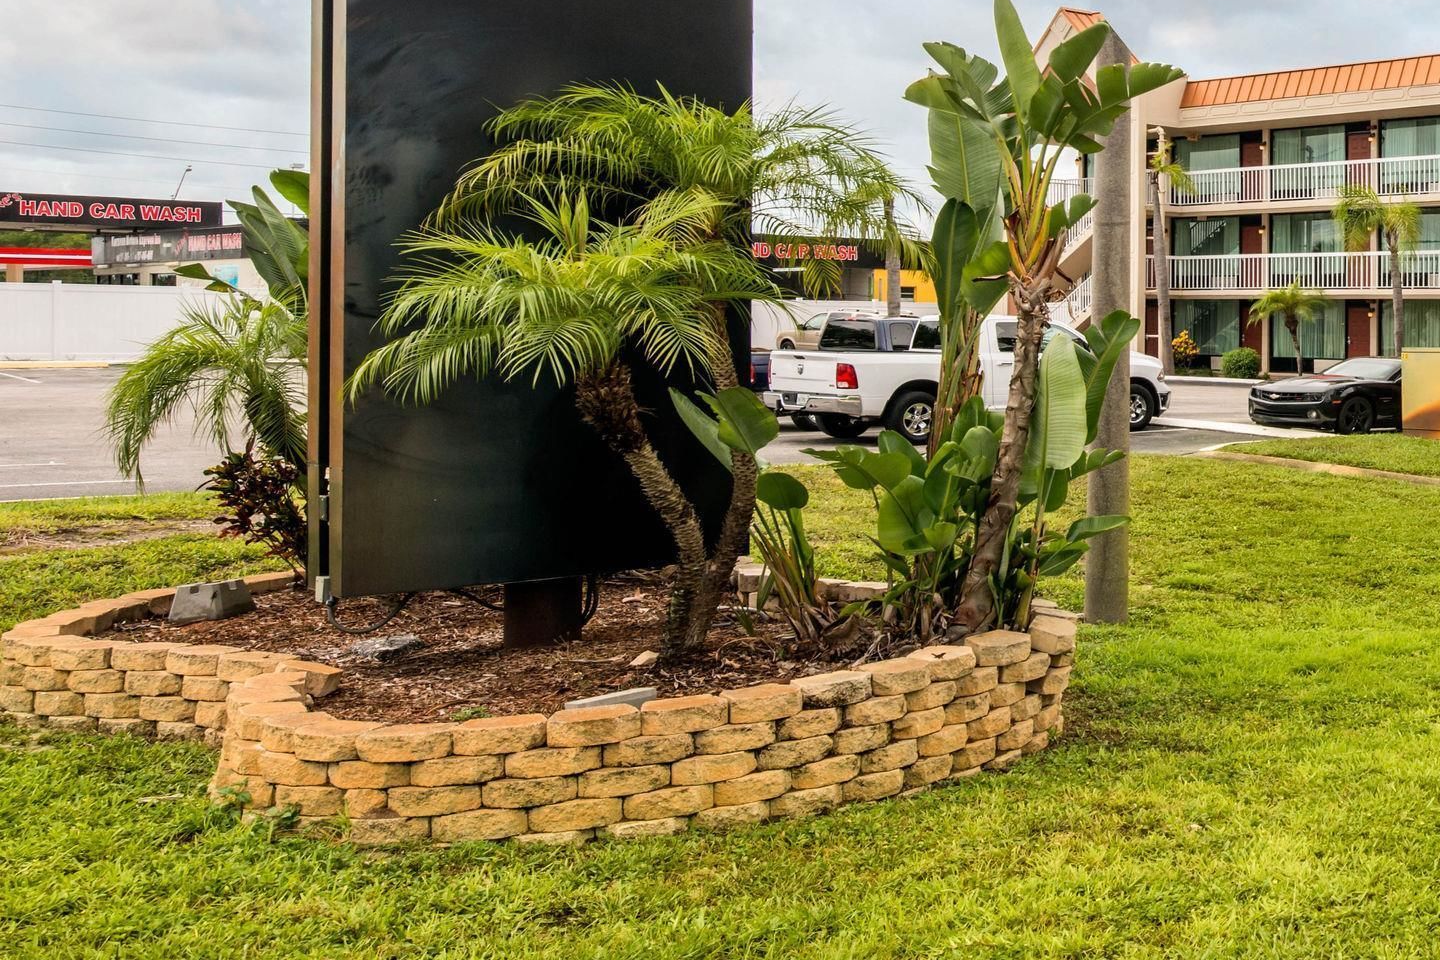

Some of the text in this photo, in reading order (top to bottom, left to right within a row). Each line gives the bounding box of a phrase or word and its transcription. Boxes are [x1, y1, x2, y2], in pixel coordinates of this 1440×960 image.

[19, 199, 202, 223] HAND CAR WASH
[751, 242, 858, 261] ND CAR WASH
